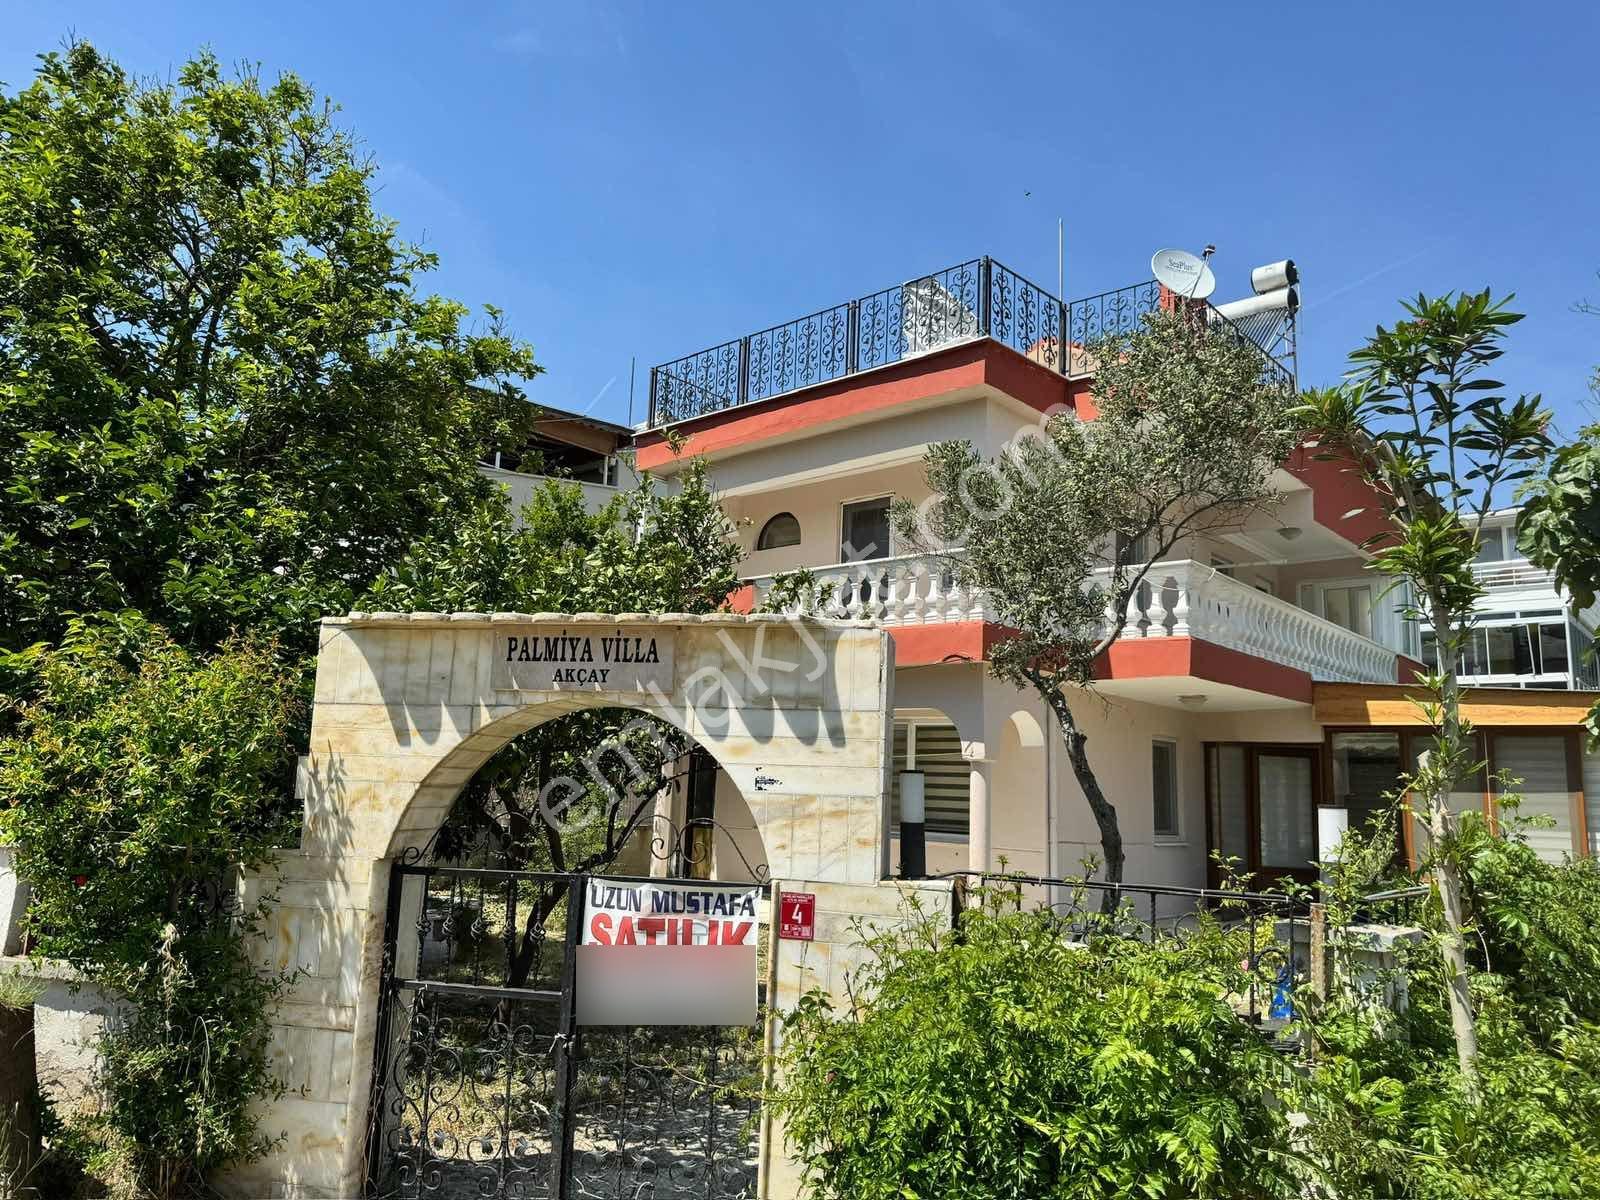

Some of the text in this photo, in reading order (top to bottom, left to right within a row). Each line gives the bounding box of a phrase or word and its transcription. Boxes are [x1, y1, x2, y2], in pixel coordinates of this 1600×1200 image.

[506, 630, 660, 664] PALMİYA VİLLA
[552, 668, 610, 686] AKÇAY
[591, 885, 756, 917] UZUN MUSTAFA
[791, 903, 802, 924] 4
